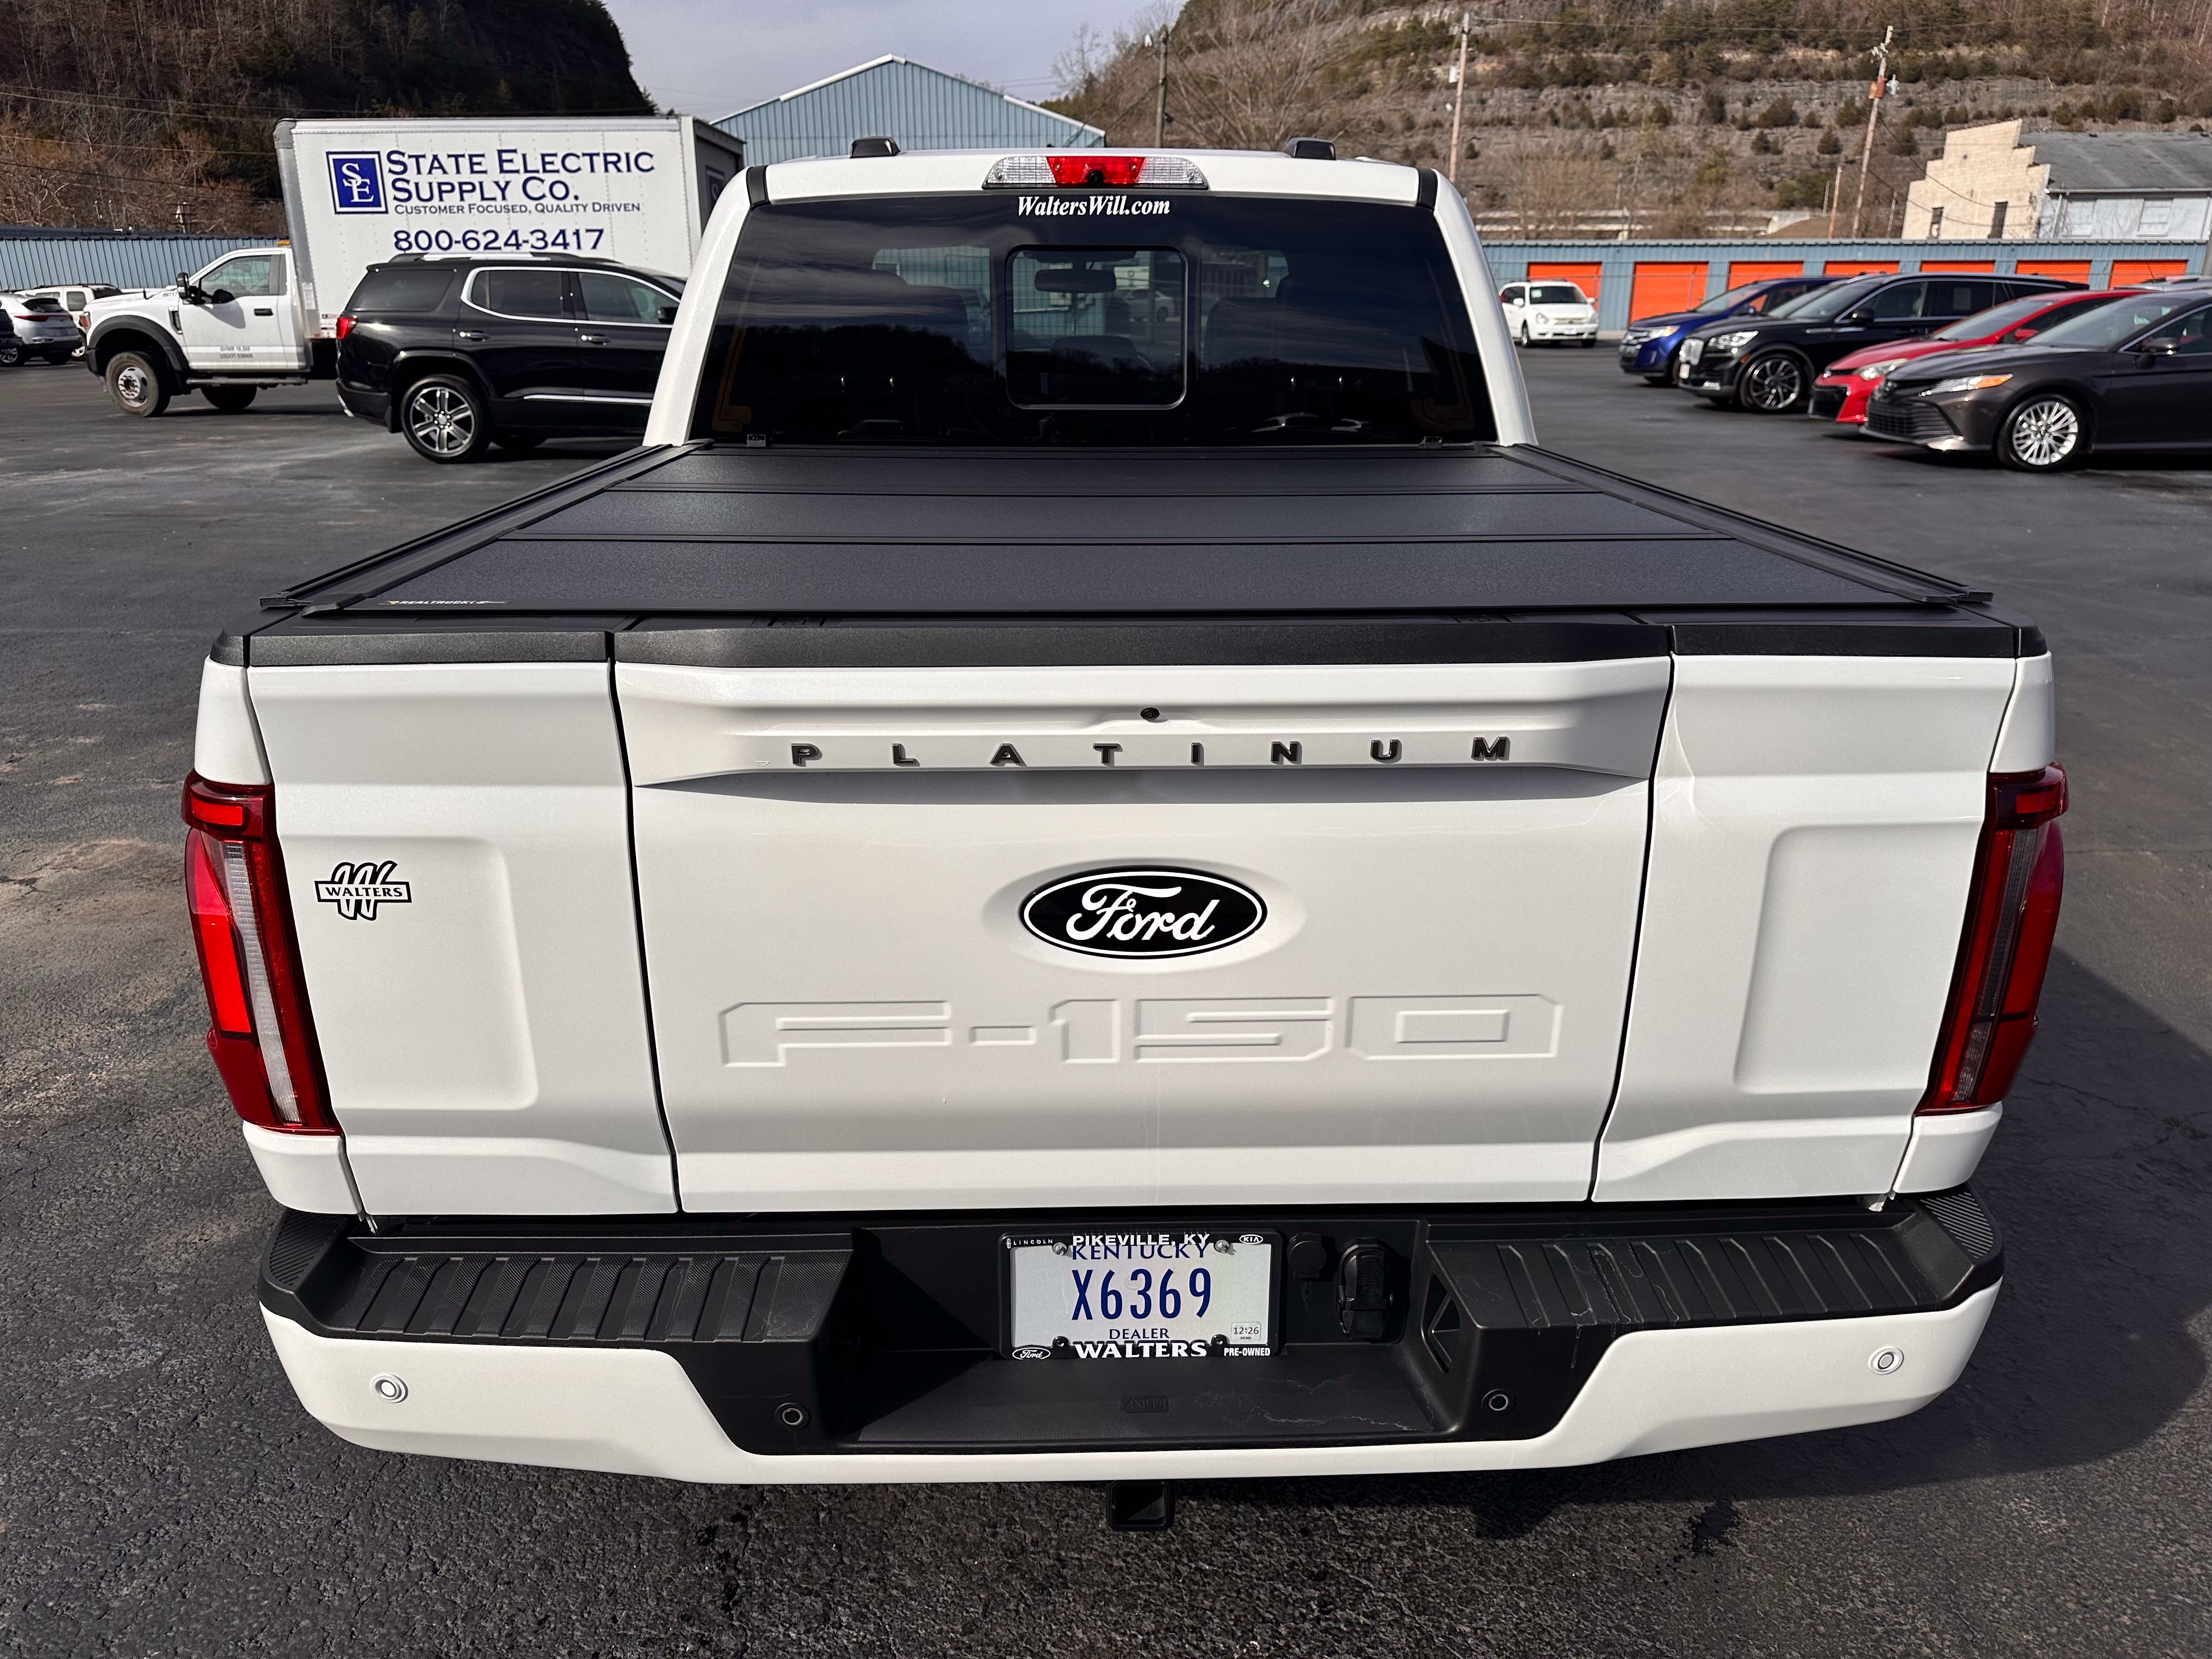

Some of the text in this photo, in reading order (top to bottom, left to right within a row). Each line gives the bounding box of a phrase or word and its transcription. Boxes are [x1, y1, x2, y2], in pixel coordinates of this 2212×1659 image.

[386, 149, 655, 176] STATE ELECTRIC
[393, 177, 510, 202] SUPPLY
[1018, 195, 1170, 216] WaltersWill.com
[393, 228, 605, 251] 800-624-3417
[791, 736, 1510, 766] PLATINUM
[325, 887, 403, 897] WALTERS
[1066, 882, 1217, 942] Ford
[718, 993, 1564, 1068] F-150
[1073, 1233, 1210, 1246] PIKEVILLE, KY
[1072, 1244, 1207, 1260] KENTUCKY
[1071, 1267, 1212, 1321] X6369
[1109, 1328, 1170, 1339] DEALER
[1018, 1349, 1043, 1359] Ford
[1073, 1342, 1207, 1358] WALTERS
[1224, 1347, 1271, 1357] PRE-OWNED
